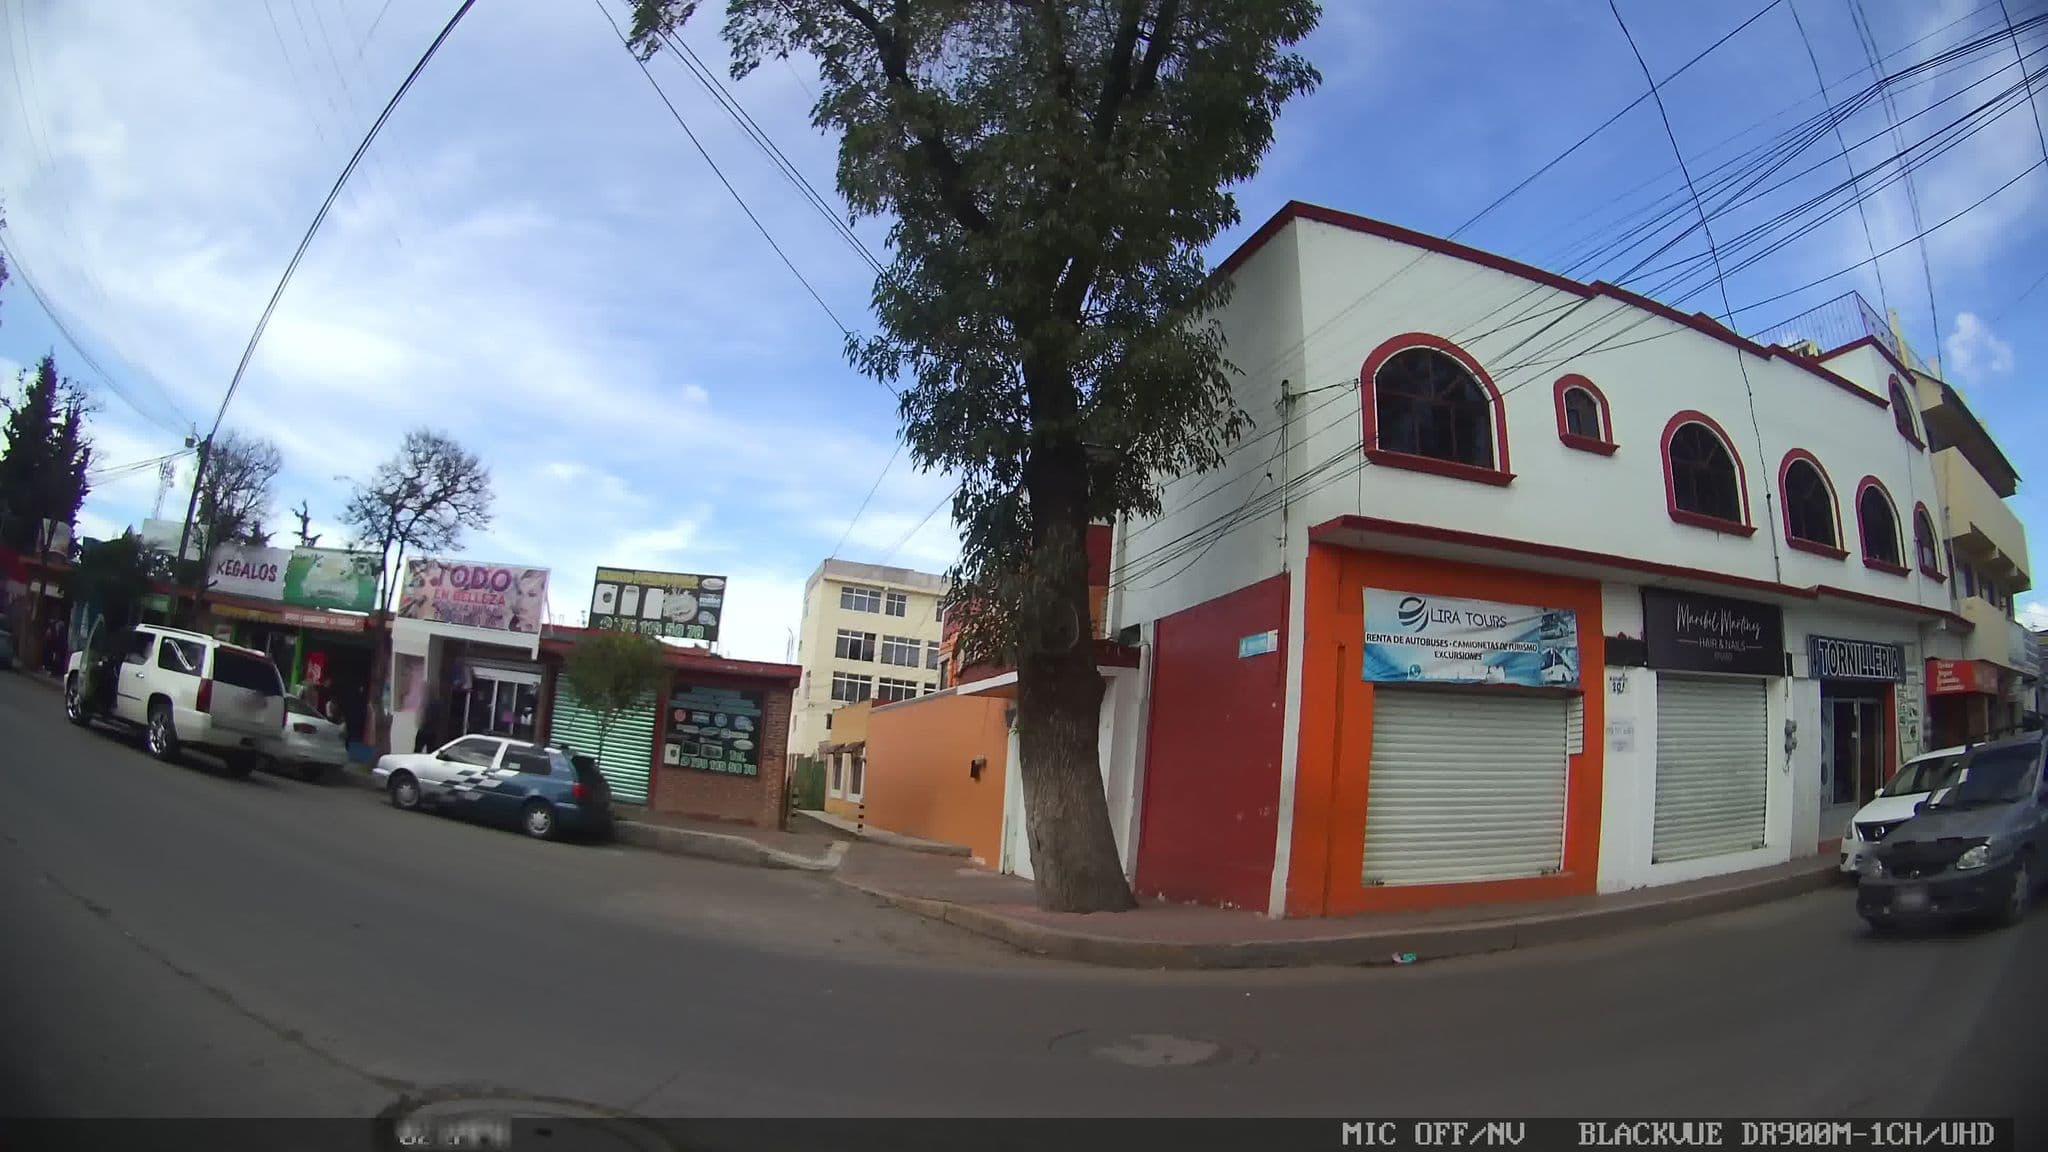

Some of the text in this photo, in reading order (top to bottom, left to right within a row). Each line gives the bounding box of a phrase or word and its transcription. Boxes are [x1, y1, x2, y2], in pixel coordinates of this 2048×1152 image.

[438, 565, 512, 592] TODO
[1430, 607, 1507, 628] LIRA TOURS
[1676, 602, 1720, 633] Maribel
[1366, 633, 1392, 643] RENTA
[1393, 635, 1404, 644] DE
[1405, 636, 1449, 648] AUTOBUSES
[1452, 641, 1499, 650] CAMIONETAS
[1508, 642, 1538, 652] TURISMO
[1434, 651, 1482, 661] EXCURSIONES
[1818, 638, 1901, 679] TORNILLERIA
